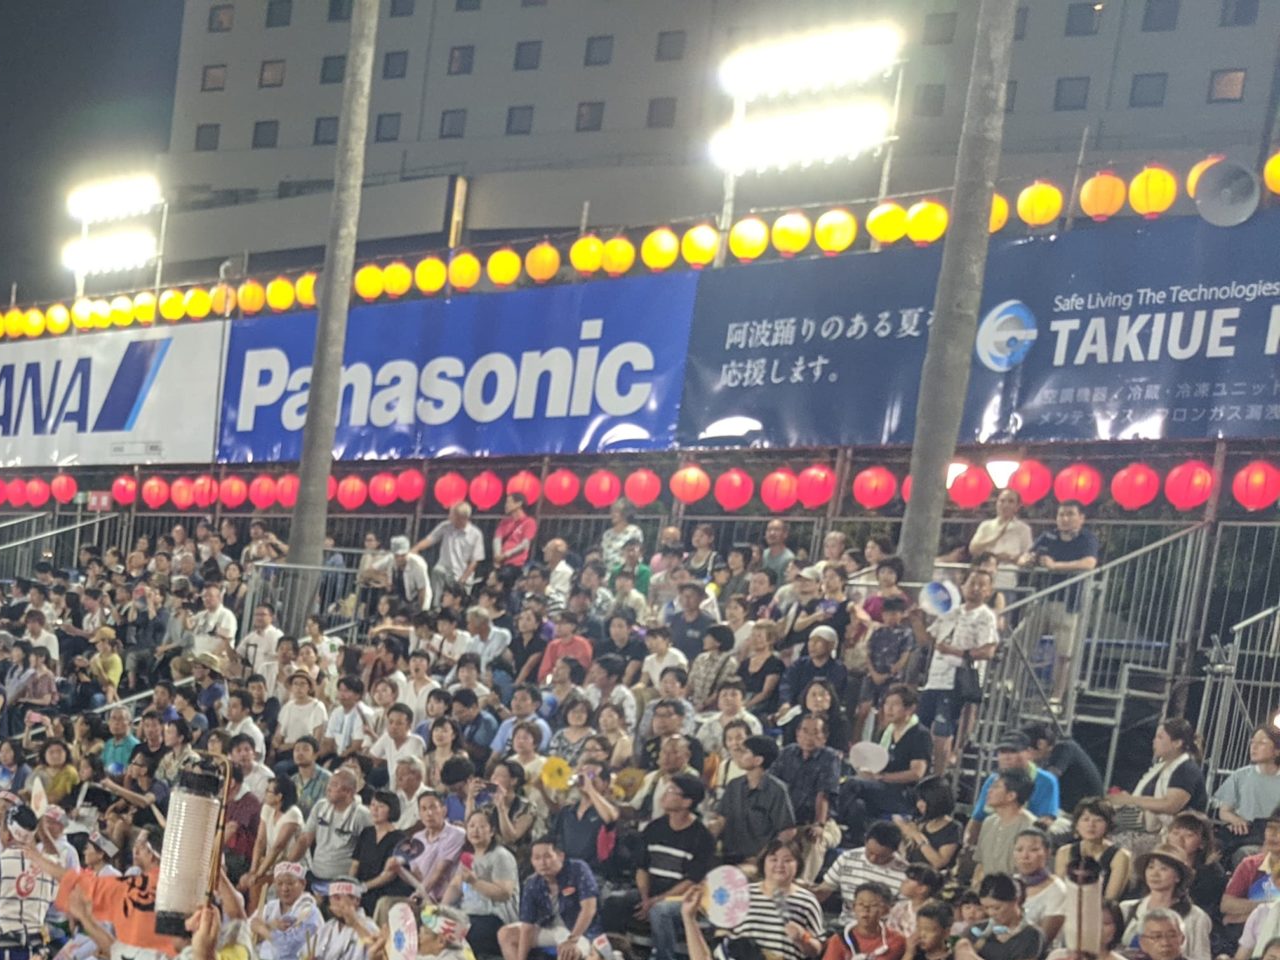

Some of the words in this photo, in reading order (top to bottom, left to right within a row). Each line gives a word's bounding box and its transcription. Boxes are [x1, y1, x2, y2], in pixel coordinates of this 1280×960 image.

[1053, 294, 1084, 312] Safe
[1087, 292, 1132, 311] Living
[1137, 287, 1167, 305] The
[1050, 307, 1241, 367] TAKIUE
[720, 354, 839, 388] 応援します。
